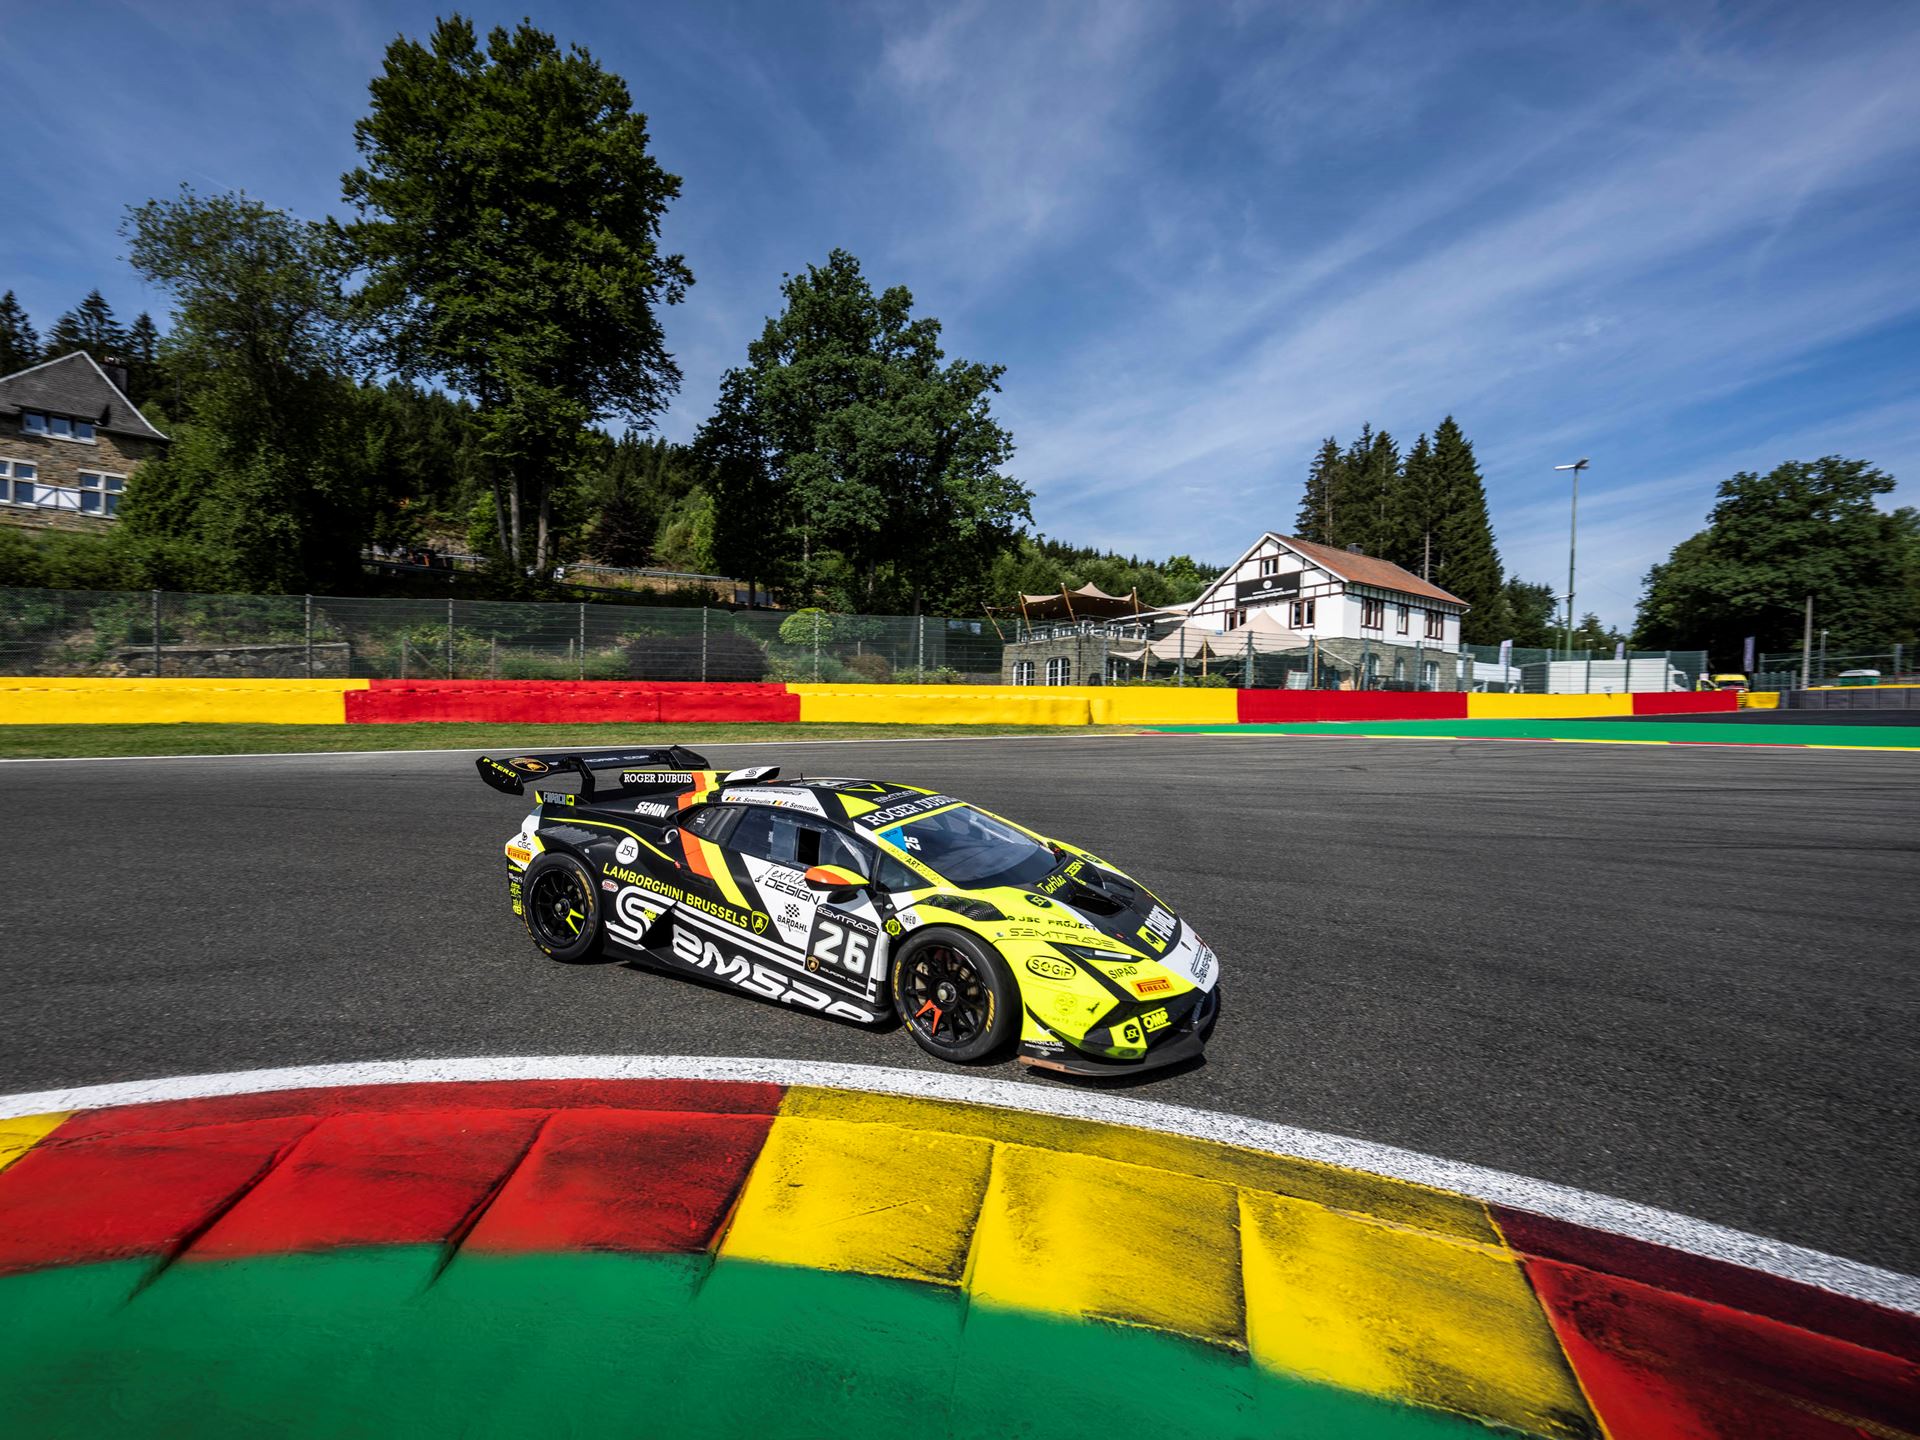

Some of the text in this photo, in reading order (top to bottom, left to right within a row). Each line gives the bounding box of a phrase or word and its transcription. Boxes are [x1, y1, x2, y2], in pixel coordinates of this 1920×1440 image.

[491, 762, 517, 778] ZERO
[623, 773, 693, 784] ROGER DUBUIS
[635, 801, 669, 818] SEMIN
[789, 802, 819, 812] Semoulin
[861, 803, 922, 826] ROGER
[517, 840, 531, 850] CGC
[904, 836, 921, 851] 26
[602, 862, 684, 902] LAMBORGHINI
[685, 893, 748, 928] BRUSSELS
[755, 874, 821, 906] & DESIGN
[777, 915, 809, 933] BARDAHL
[816, 906, 879, 936] SEMTRADE
[1047, 919, 1097, 931] PROJECT
[1009, 927, 1117, 949] SEMTRADE
[813, 920, 869, 974] 26
[1108, 965, 1138, 979] SIPAD
[1136, 979, 1171, 993] PIRELLI
[1142, 1009, 1170, 1030] OMP
